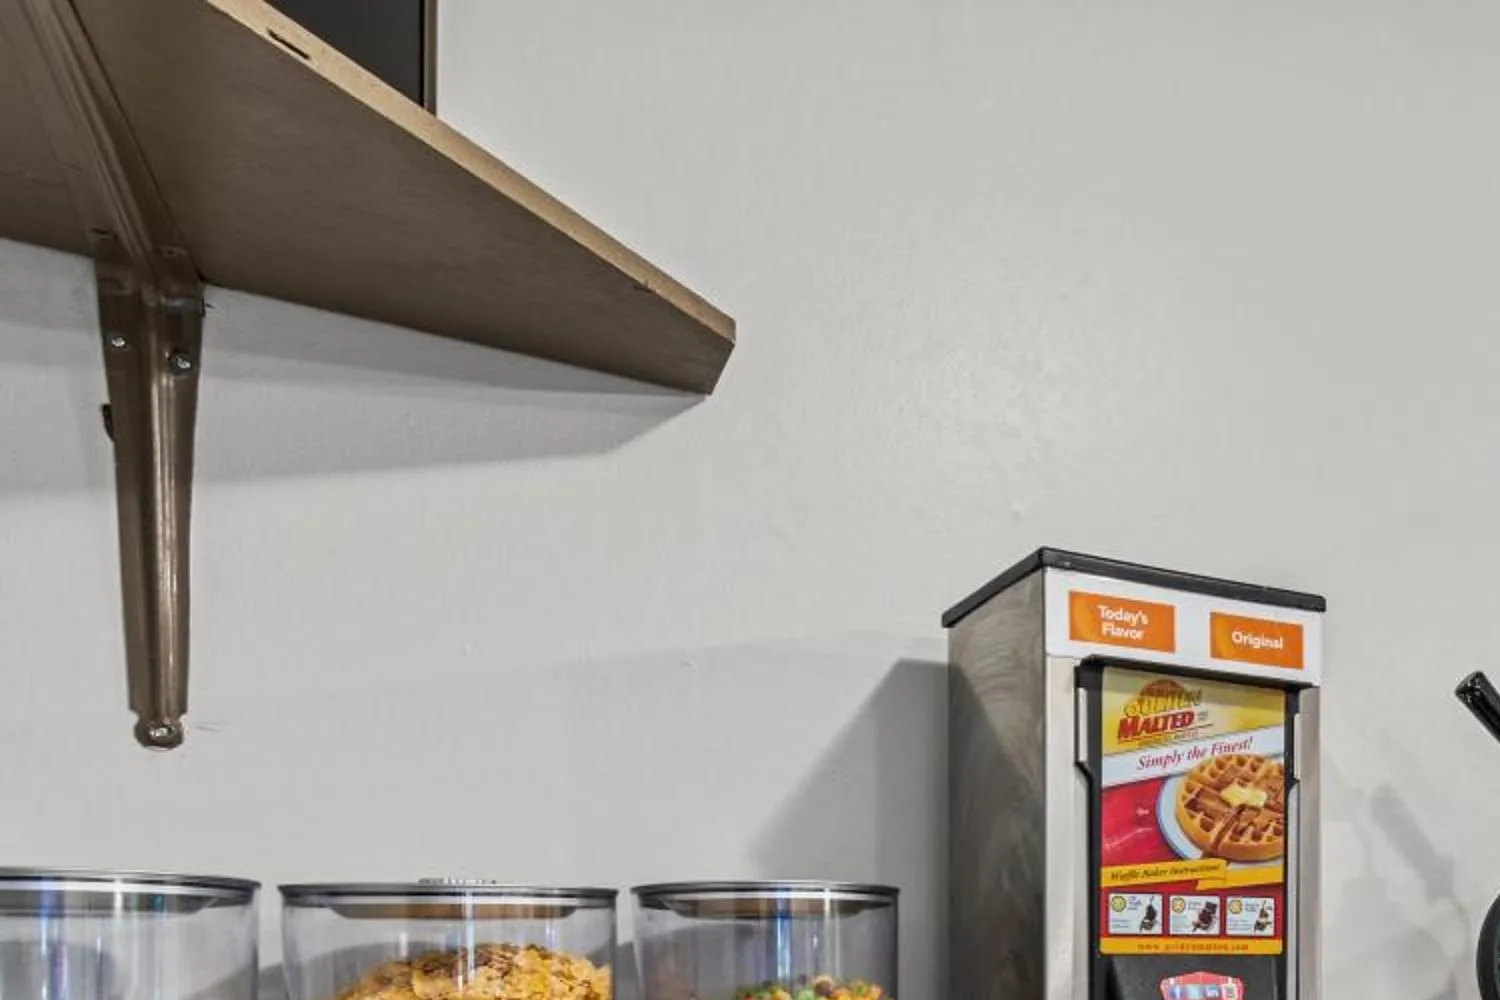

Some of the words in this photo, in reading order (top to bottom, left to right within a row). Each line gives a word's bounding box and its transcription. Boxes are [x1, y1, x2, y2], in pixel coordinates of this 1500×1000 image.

[1098, 604, 1149, 626] Today's
[1102, 622, 1145, 641] Flavor
[1231, 629, 1284, 650] Original
[1117, 711, 1195, 739] MALTED
[1136, 749, 1185, 770] Simply
[1187, 745, 1208, 761] the
[1210, 736, 1254, 757] Finest!
